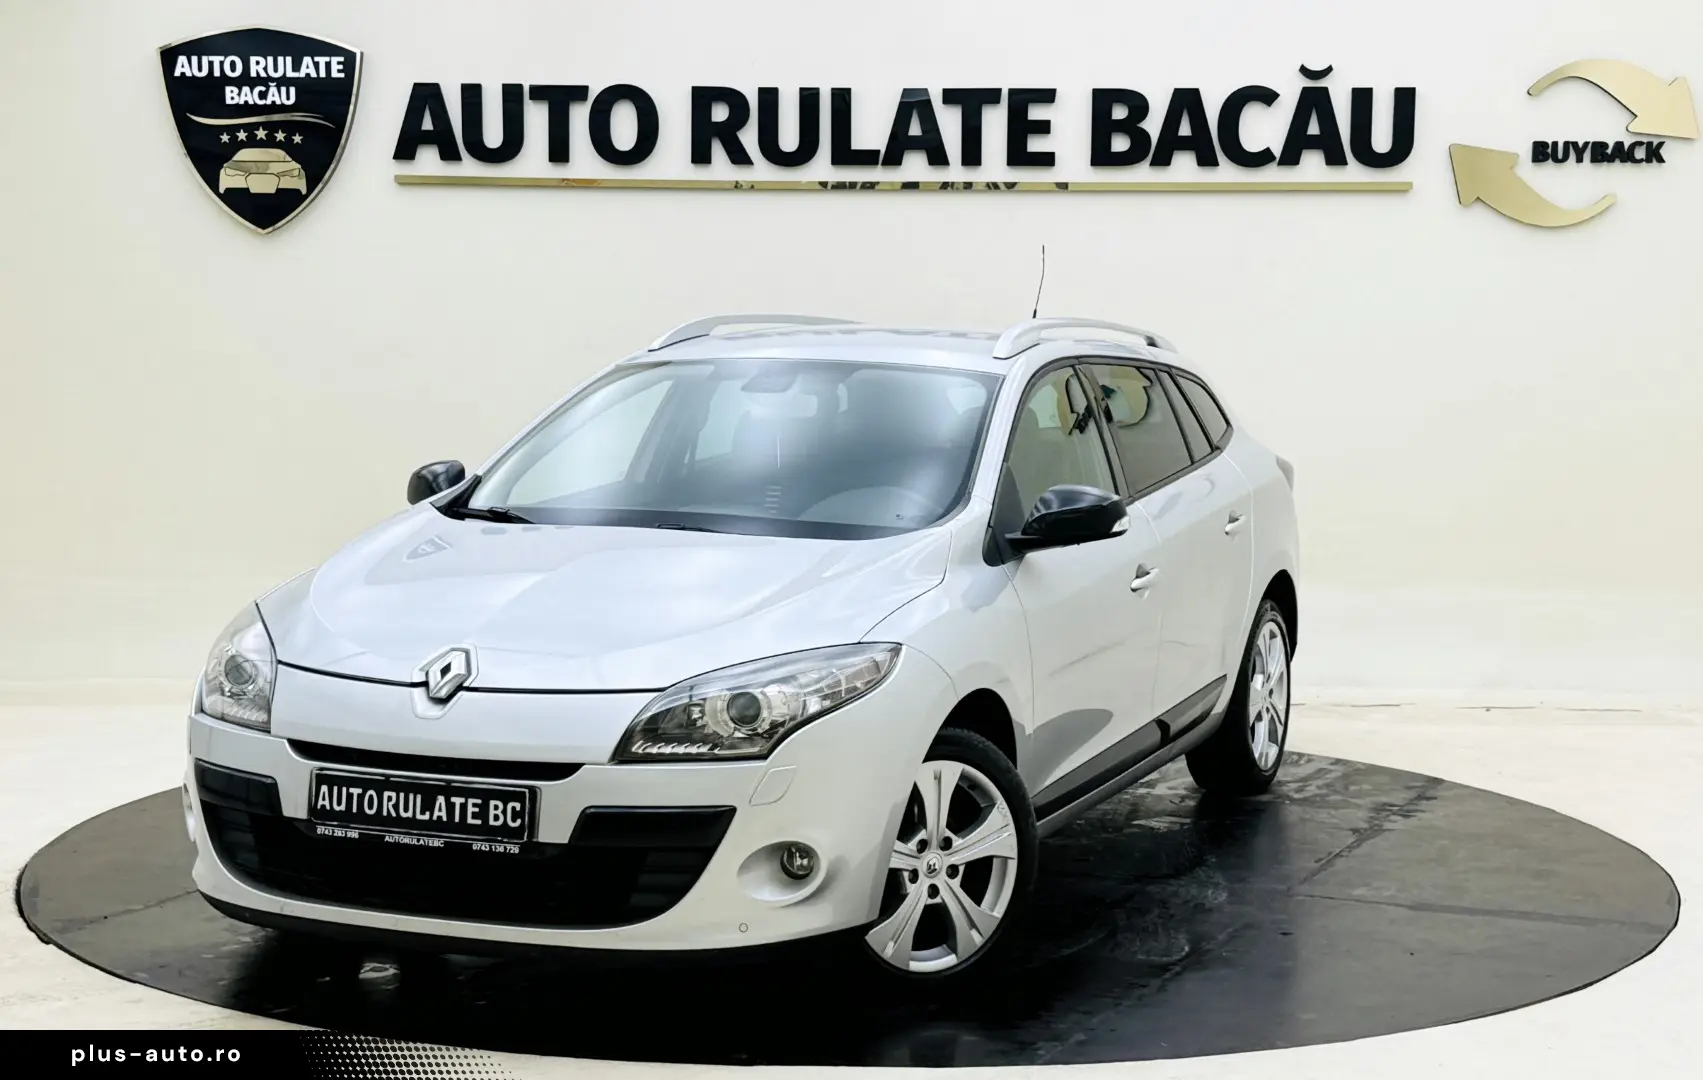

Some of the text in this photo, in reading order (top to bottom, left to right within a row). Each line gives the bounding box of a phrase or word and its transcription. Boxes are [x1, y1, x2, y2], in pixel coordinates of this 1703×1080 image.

[174, 56, 345, 79] AUTO RULATE
[224, 82, 296, 105] BACĂU
[393, 64, 1416, 168] AUTO RULATE BACĂU
[1531, 140, 1666, 164] BUYBACK
[489, 800, 522, 828] BC
[384, 835, 445, 848] AUTORULATEBC
[472, 843, 490, 851] 0743
[491, 845, 505, 853] 136
